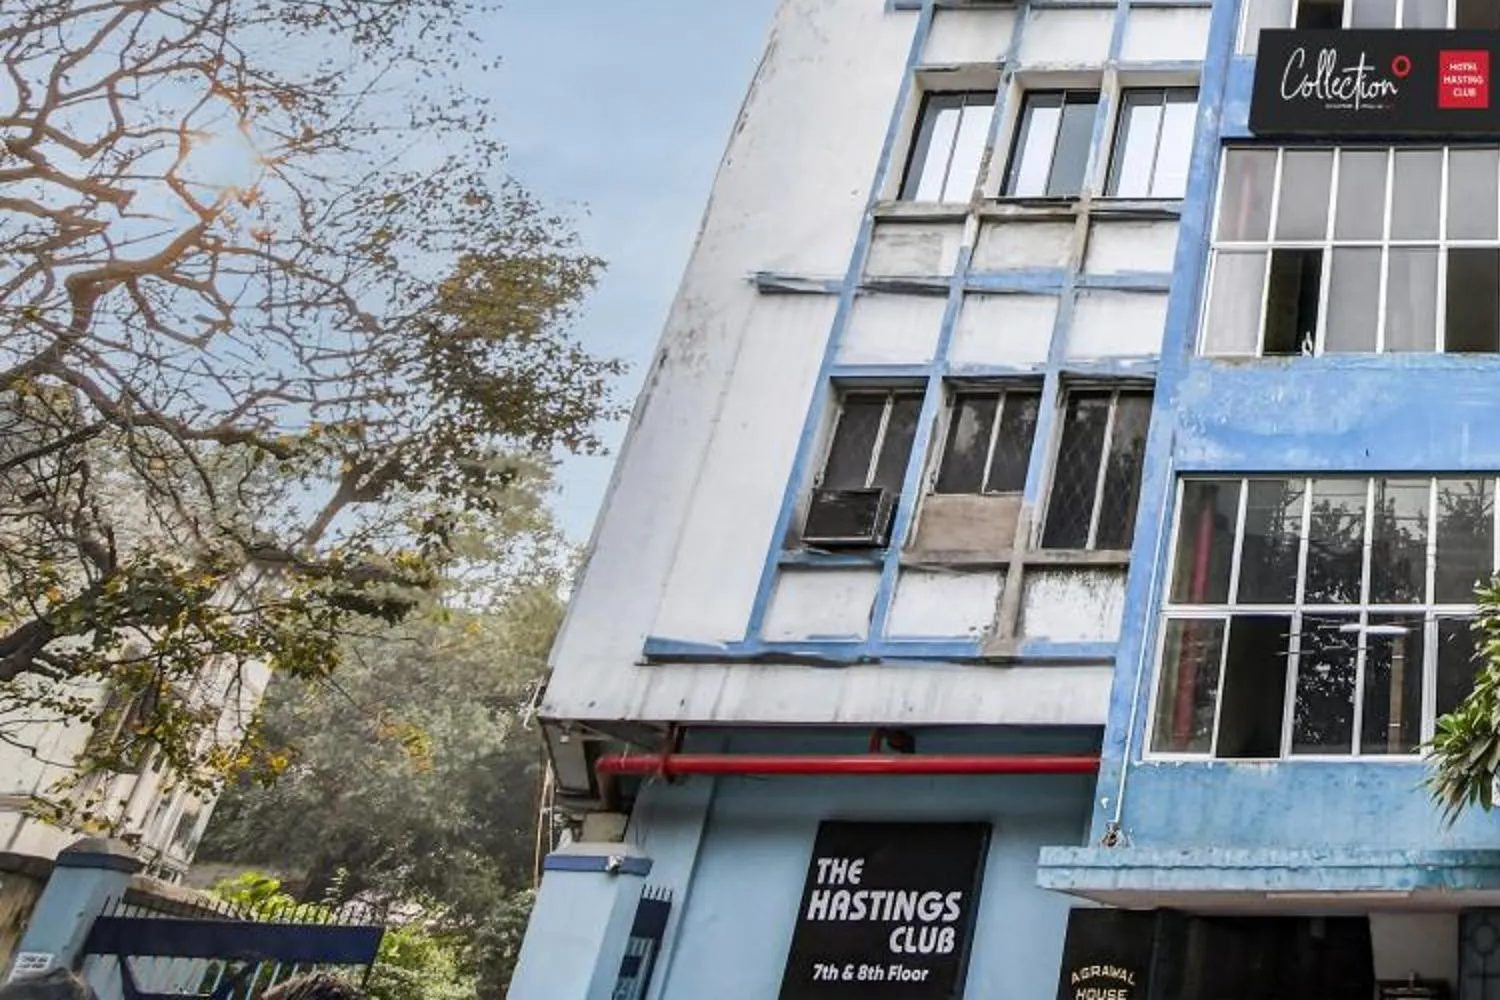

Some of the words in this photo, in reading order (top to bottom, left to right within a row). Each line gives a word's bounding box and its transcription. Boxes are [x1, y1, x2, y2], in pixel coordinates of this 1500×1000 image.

[1449, 62, 1477, 71] HOTEL
[1281, 47, 1398, 110] Collection
[1453, 87, 1477, 97] CLUB
[817, 858, 864, 884] THE
[807, 890, 962, 922] HASTINGS
[889, 926, 955, 953] CLUB
[813, 963, 838, 981] 7th
[841, 964, 855, 981] &
[857, 964, 884, 981] 8th
[887, 965, 929, 981] Floor
[1071, 964, 1136, 987] AGRAWAL
[1075, 987, 1130, 1000] HOUSE
